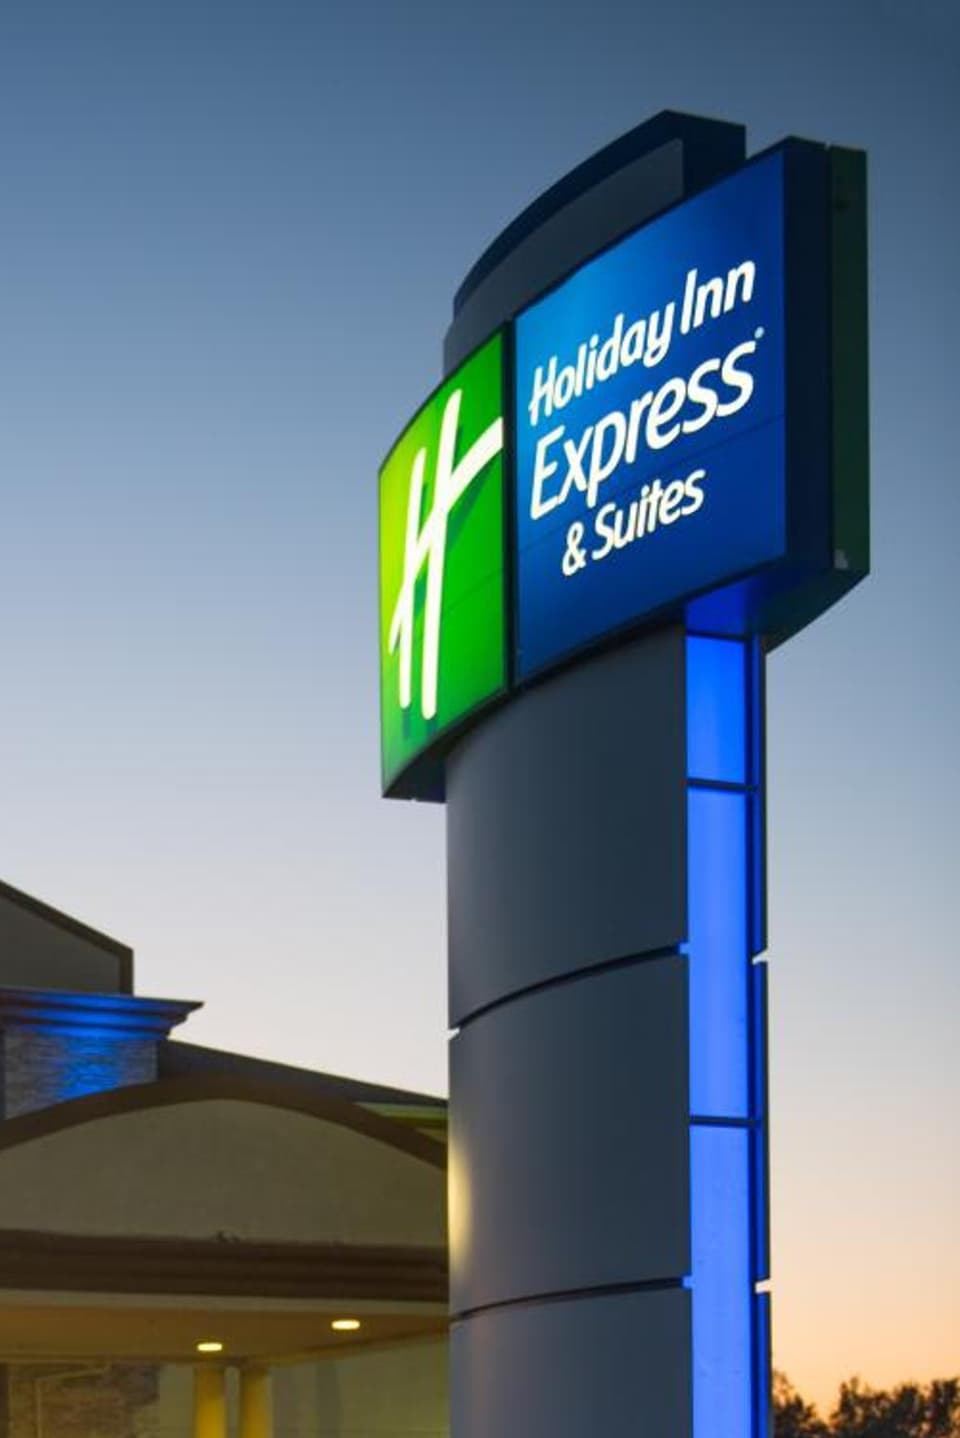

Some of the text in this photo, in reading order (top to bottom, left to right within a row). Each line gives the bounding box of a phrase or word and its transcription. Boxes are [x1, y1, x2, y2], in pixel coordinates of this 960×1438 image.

[528, 261, 756, 426] Holiday Inn
[530, 340, 757, 520] Express
[388, 390, 503, 720] H
[561, 469, 706, 576] & Suites
